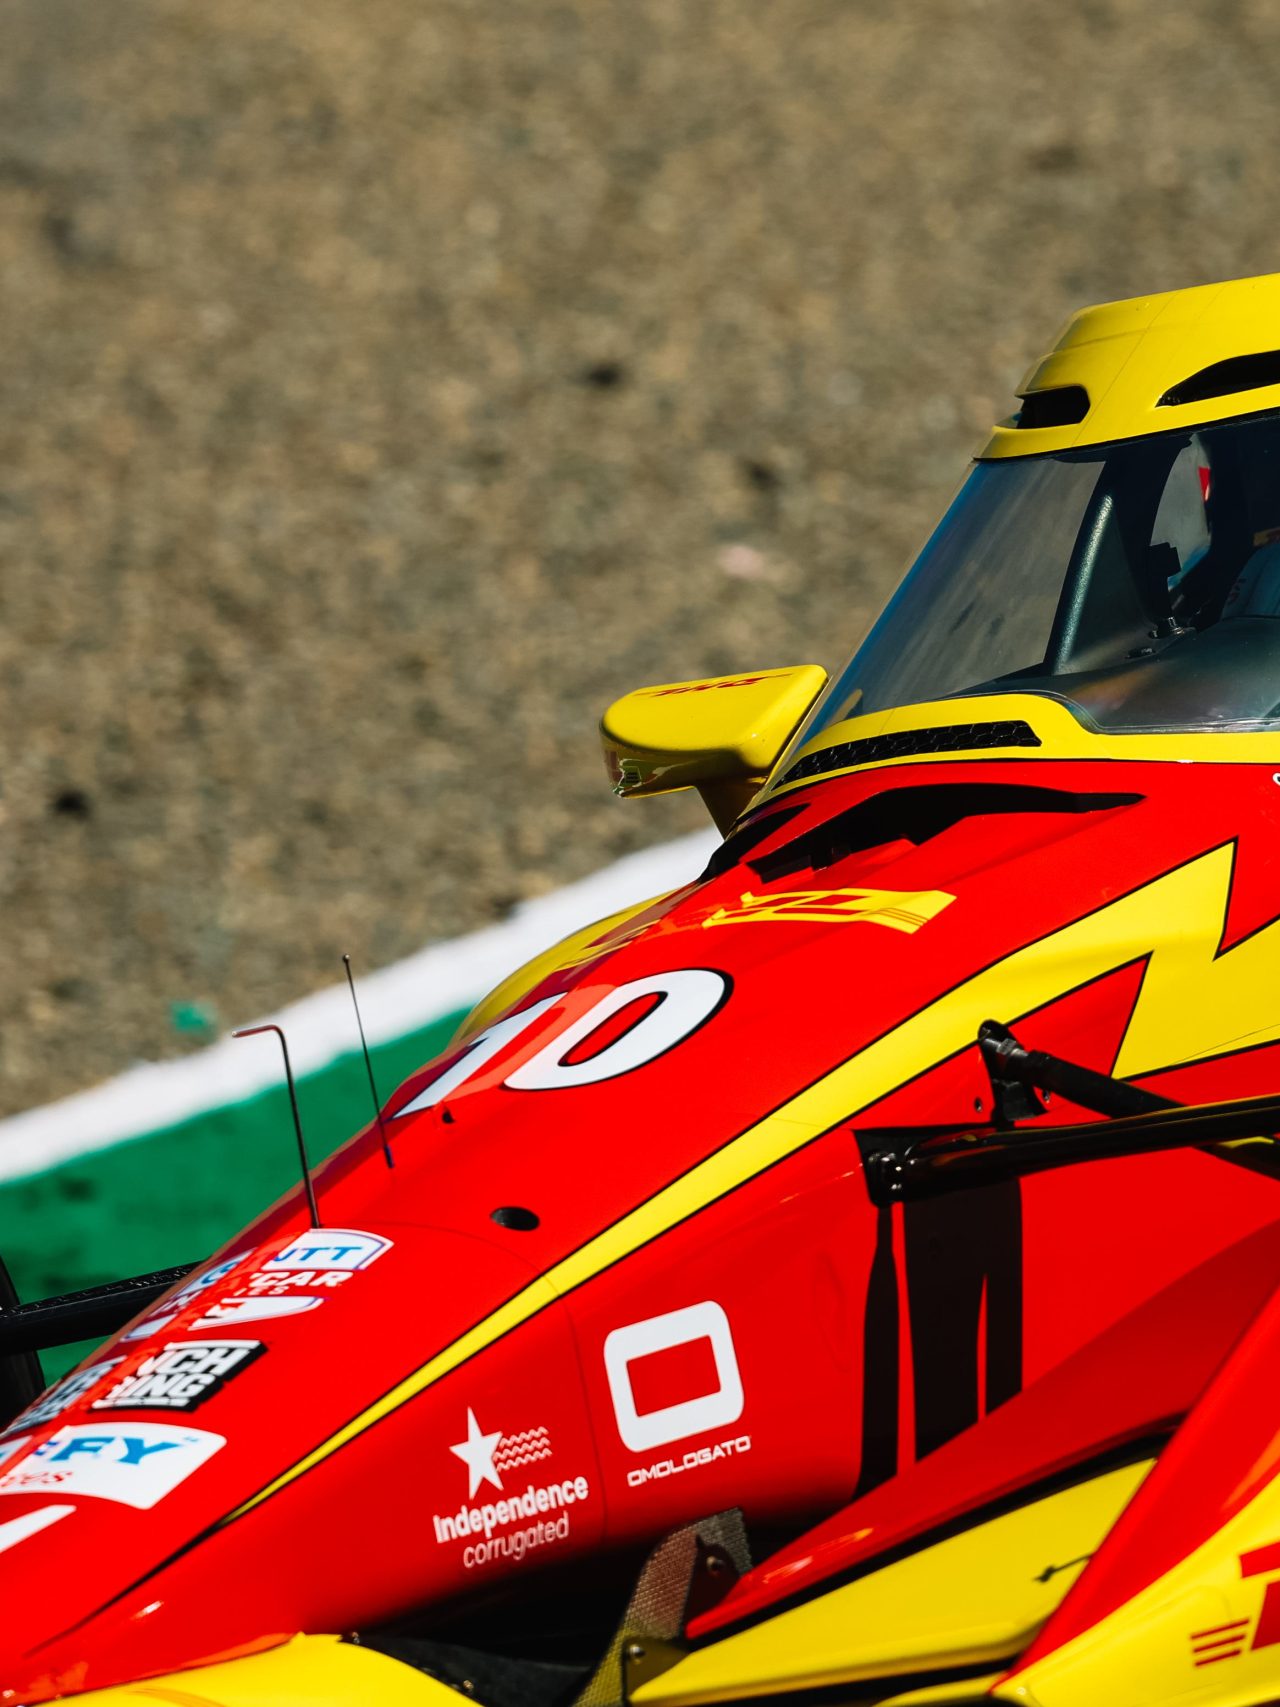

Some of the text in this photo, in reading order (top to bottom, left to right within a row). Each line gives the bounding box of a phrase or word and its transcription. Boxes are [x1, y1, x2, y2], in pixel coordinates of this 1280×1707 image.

[627, 1435, 751, 1488] OMOLOGATO
[433, 1475, 590, 1544] Independence
[463, 1510, 571, 1569] corrugated
